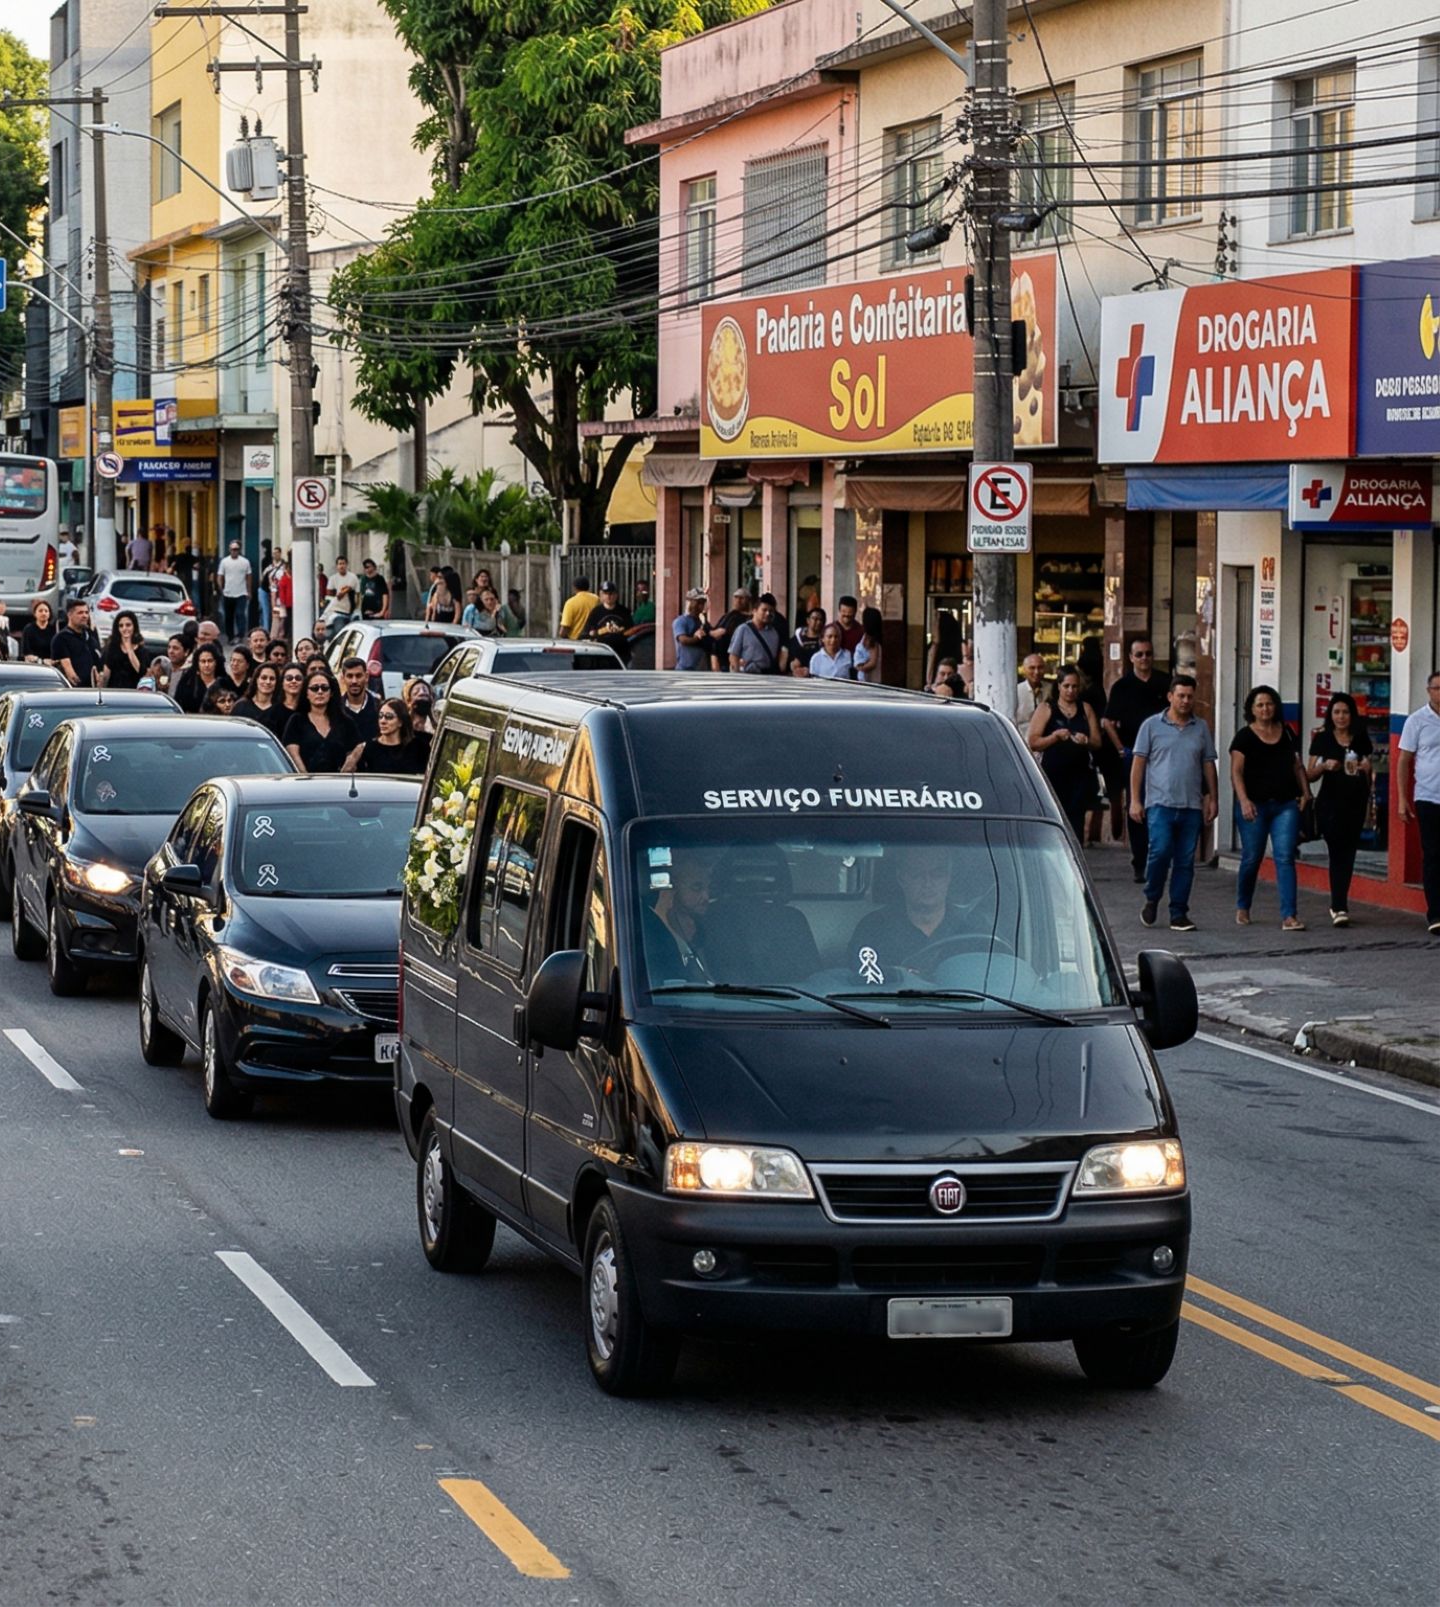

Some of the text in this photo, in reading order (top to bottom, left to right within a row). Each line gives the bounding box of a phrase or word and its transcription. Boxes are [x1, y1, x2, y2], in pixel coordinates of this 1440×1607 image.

[755, 280, 967, 355] Padaria e Confeitaria
[1198, 304, 1318, 354] DROGARIA
[829, 354, 887, 432] Sol
[1180, 359, 1331, 438] ALIANÇA
[1344, 493, 1426, 509] ALIANÇA
[1350, 479, 1422, 490] DROGARIA
[703, 785, 983, 812] SERVIÇO FUNERÁRIO
[937, 1187, 960, 1206] FIAT
